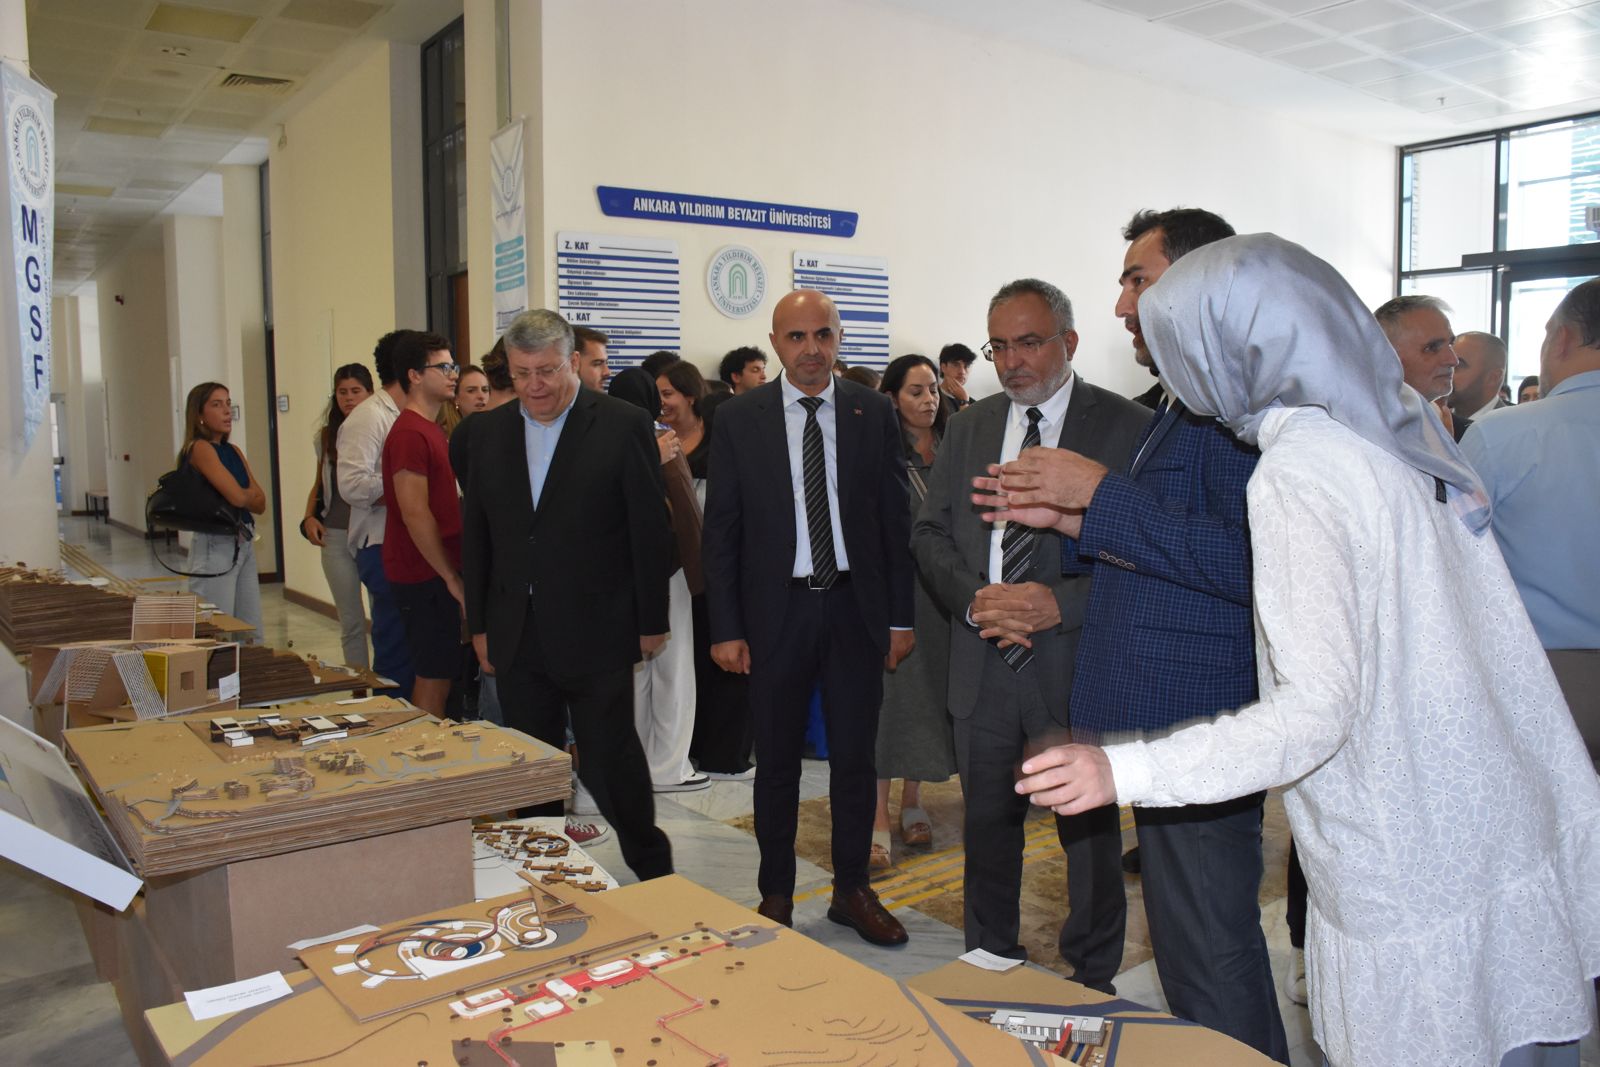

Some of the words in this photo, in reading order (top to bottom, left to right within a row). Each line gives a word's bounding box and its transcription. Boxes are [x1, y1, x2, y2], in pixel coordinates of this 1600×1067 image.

[633, 197, 677, 215] ANKARA
[678, 201, 725, 219] YILDIRIM
[727, 205, 767, 223] BEYAZIT
[769, 208, 832, 230] ÜNİVERSİTESİ
[574, 241, 590, 251] KAT
[806, 259, 819, 268] KAT
[21, 204, 44, 390] MGSF
[566, 312, 574, 321] 1.
[576, 312, 591, 322] KAT
